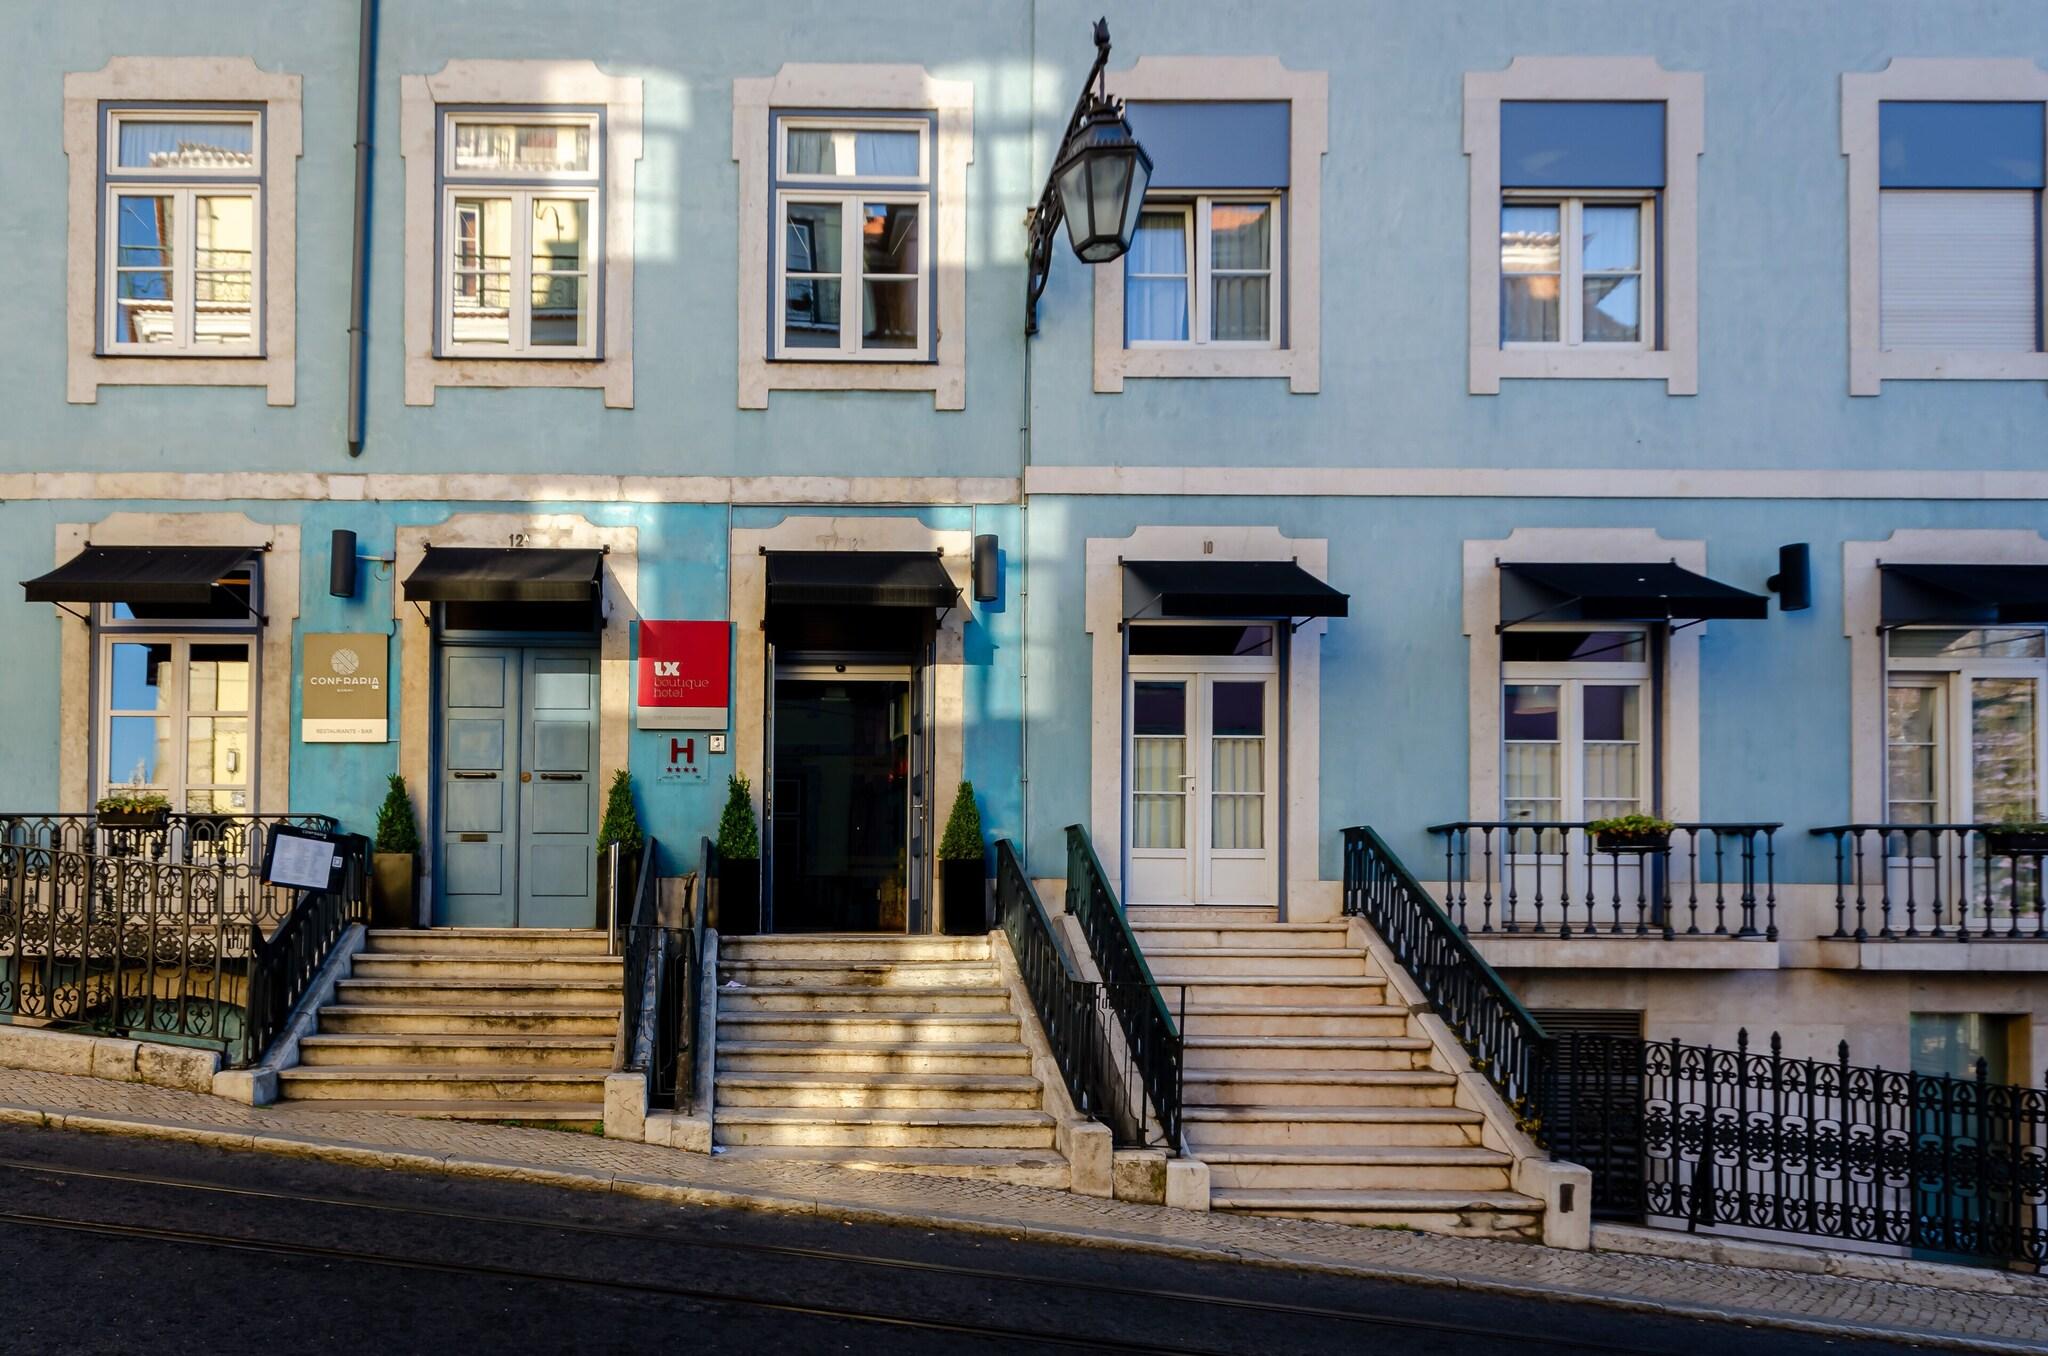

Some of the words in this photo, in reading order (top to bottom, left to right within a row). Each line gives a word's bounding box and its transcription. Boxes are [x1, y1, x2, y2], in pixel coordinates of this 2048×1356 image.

[1203, 540, 1213, 554] 10
[310, 676, 380, 685] CONFRARIA
[654, 677, 710, 690] boutique
[653, 688, 684, 698] hotel
[671, 737, 695, 764] H
